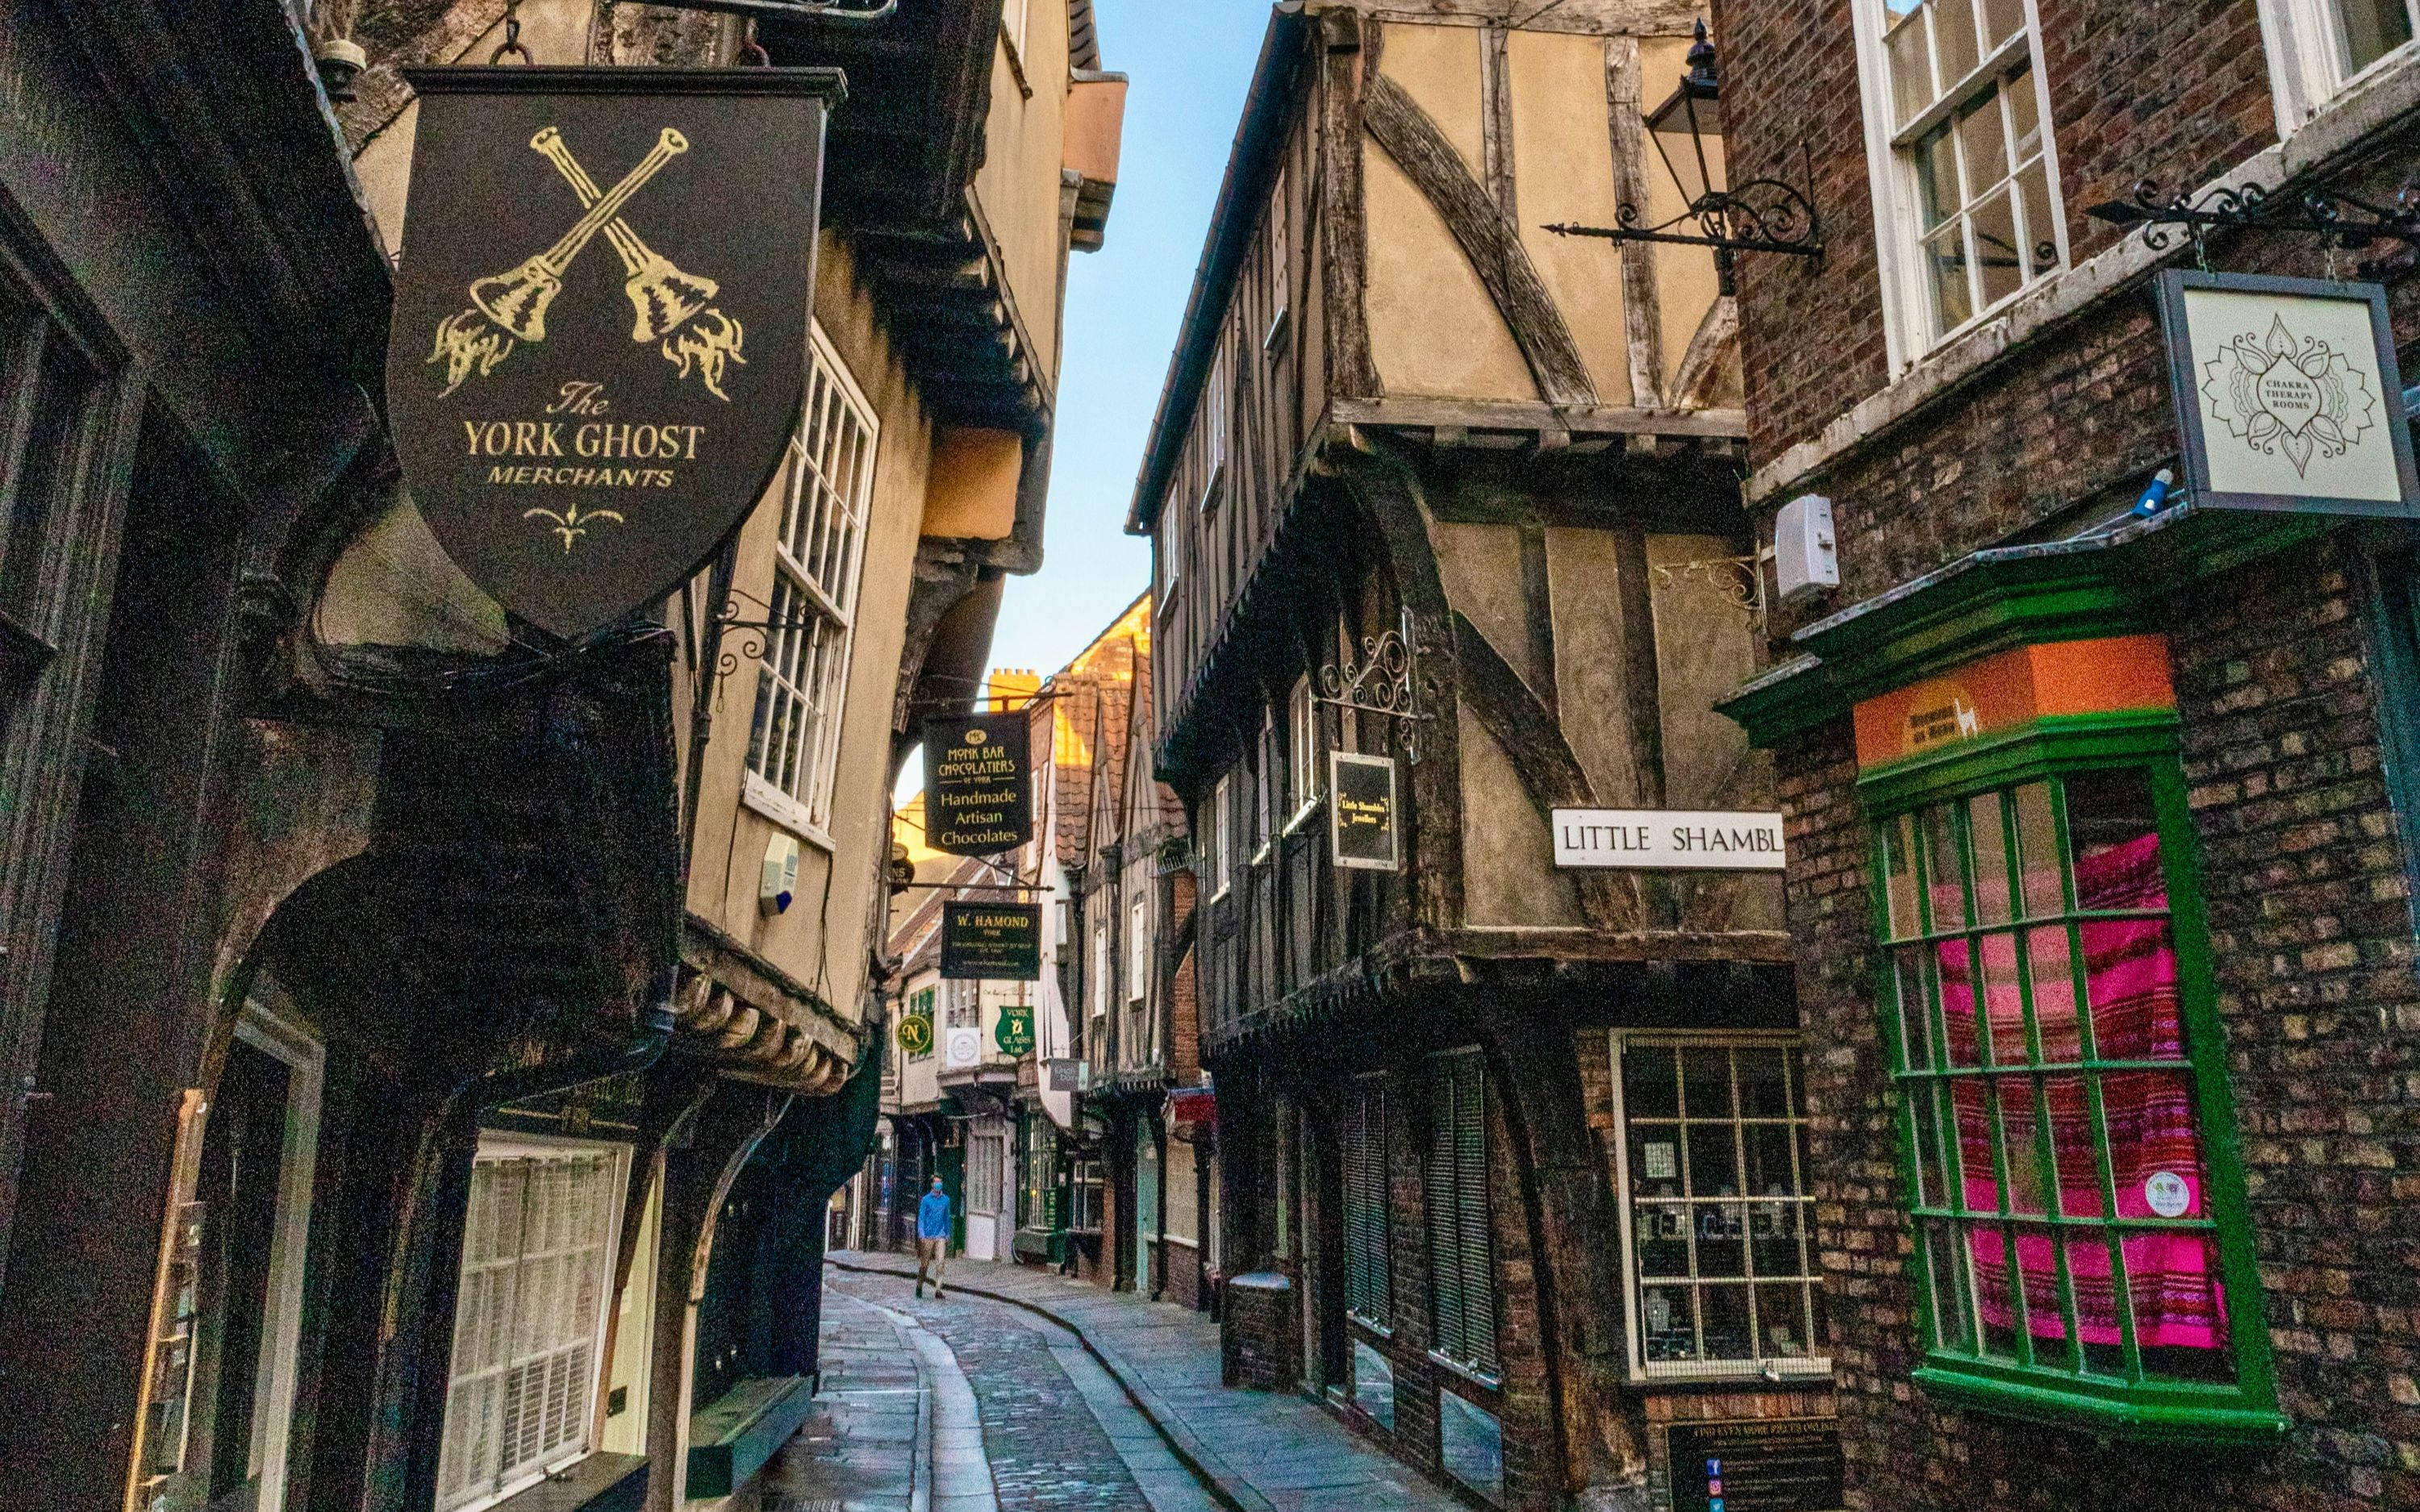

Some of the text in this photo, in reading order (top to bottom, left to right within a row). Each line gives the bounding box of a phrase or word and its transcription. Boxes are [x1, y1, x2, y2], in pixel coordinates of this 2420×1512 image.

[2266, 380, 2309, 389] CHAKRA
[546, 381, 610, 416] The
[2267, 390, 2313, 400] THERAPY
[2272, 400, 2309, 410] ROOMS
[464, 420, 705, 460] YORK GHOST
[487, 466, 674, 488] MERCHANTS
[948, 745, 1004, 761] MONK BAR
[938, 760, 1016, 777] CHOCOLATIERS
[941, 788, 1017, 806] Handmade
[1342, 799, 1358, 810] Little
[955, 810, 1003, 825] Artisan
[1352, 813, 1377, 824] Jewellers
[941, 829, 1018, 845] Chocolates
[1563, 825, 1784, 852] LITTLE SHAMBL
[957, 914, 1029, 927] W. HAMOND
[1007, 1008, 1028, 1017] YORK
